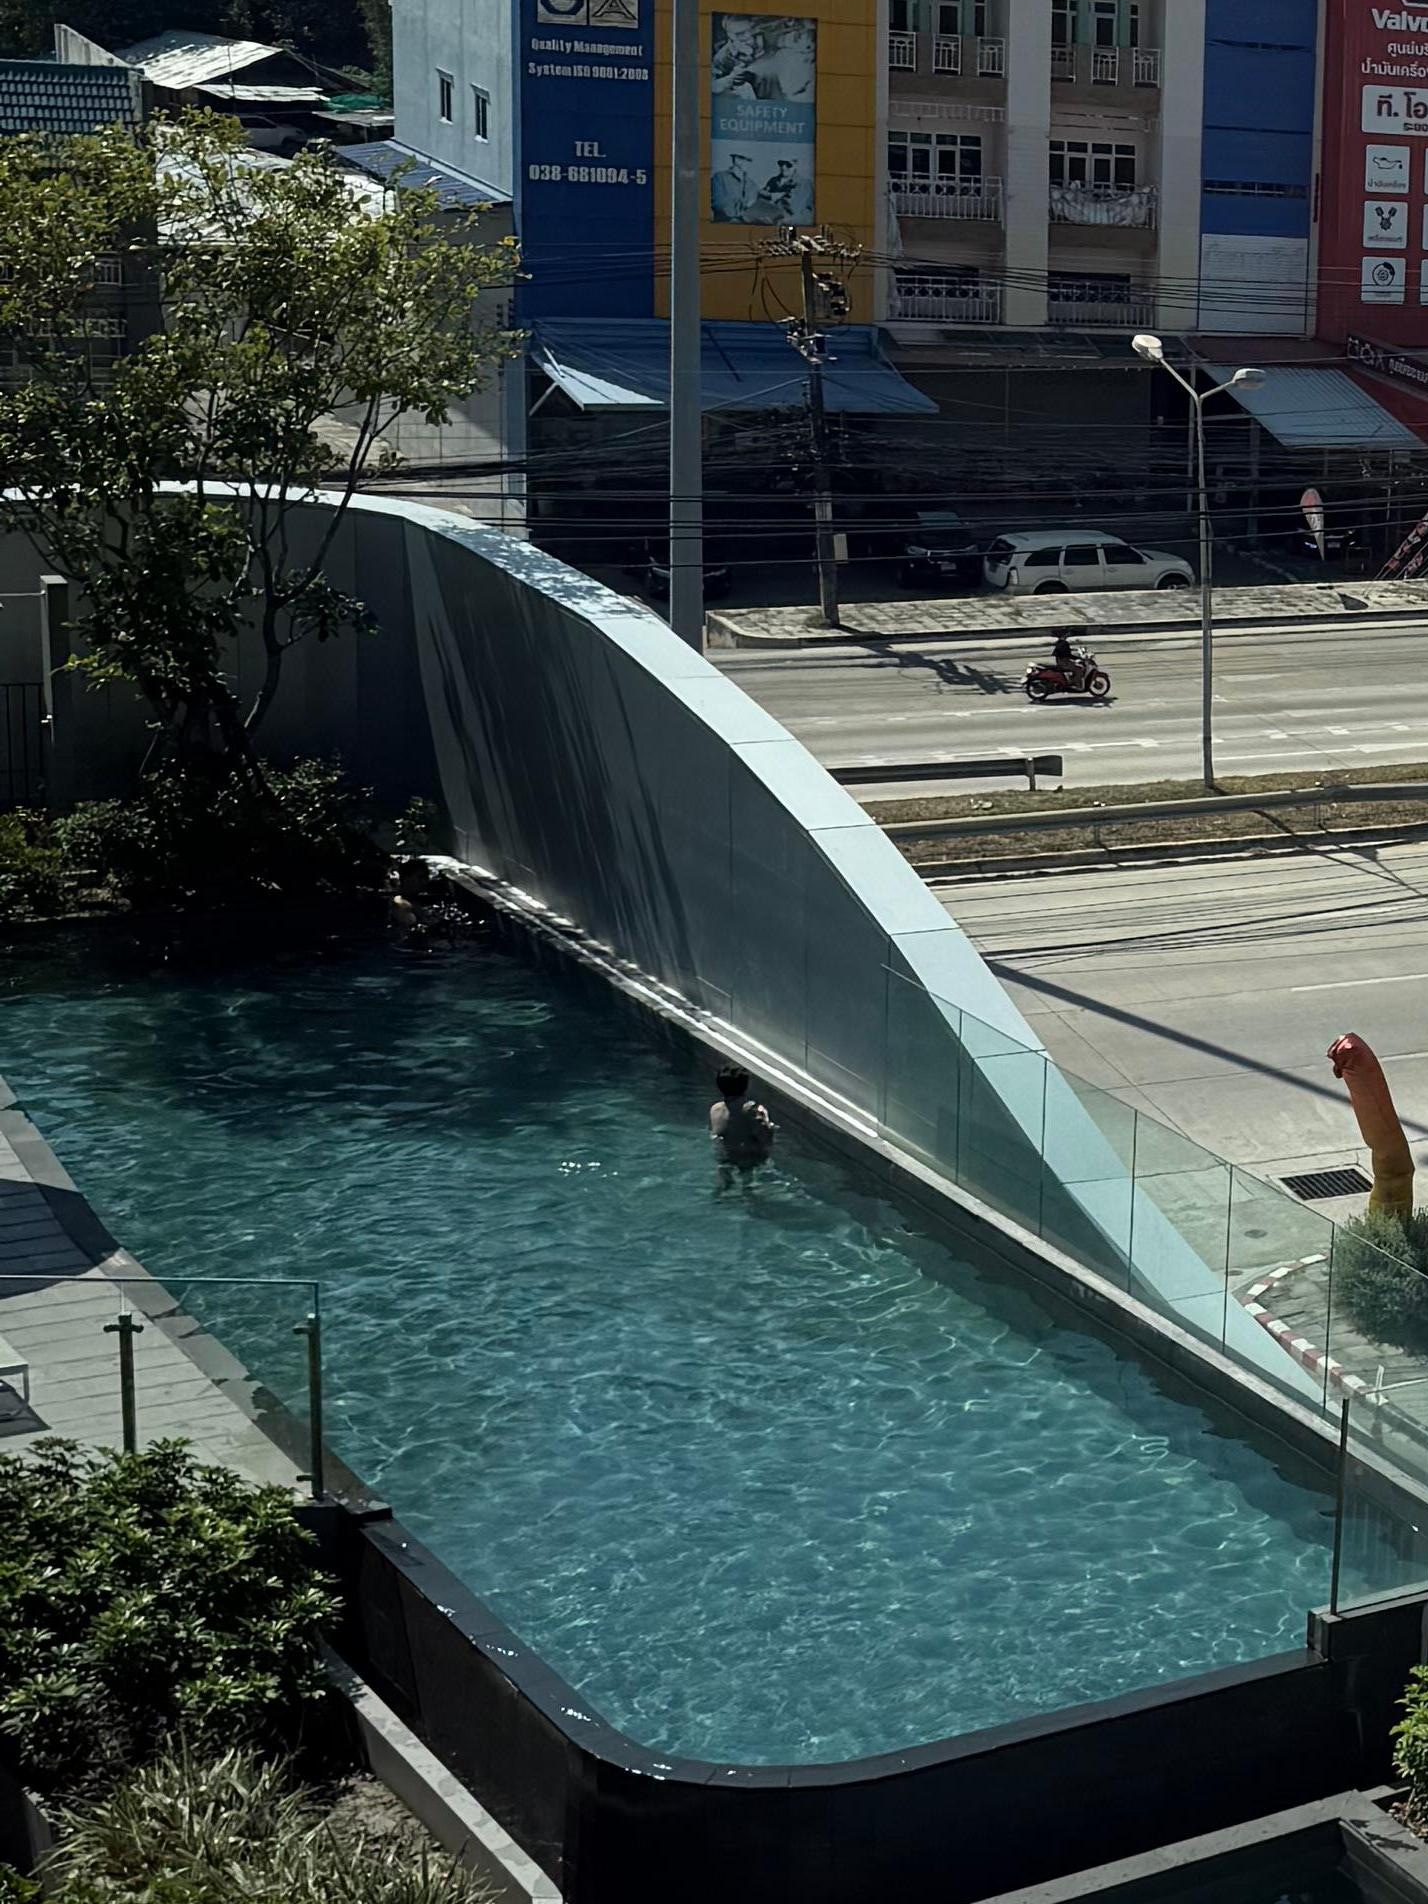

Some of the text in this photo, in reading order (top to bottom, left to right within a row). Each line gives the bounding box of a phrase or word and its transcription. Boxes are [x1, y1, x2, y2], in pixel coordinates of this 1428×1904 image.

[531, 37, 644, 57] Quality Management
[528, 61, 572, 78] System
[736, 105, 789, 119] SAFETY
[719, 118, 807, 135] EQUIPMENT
[574, 140, 607, 158] TEL.
